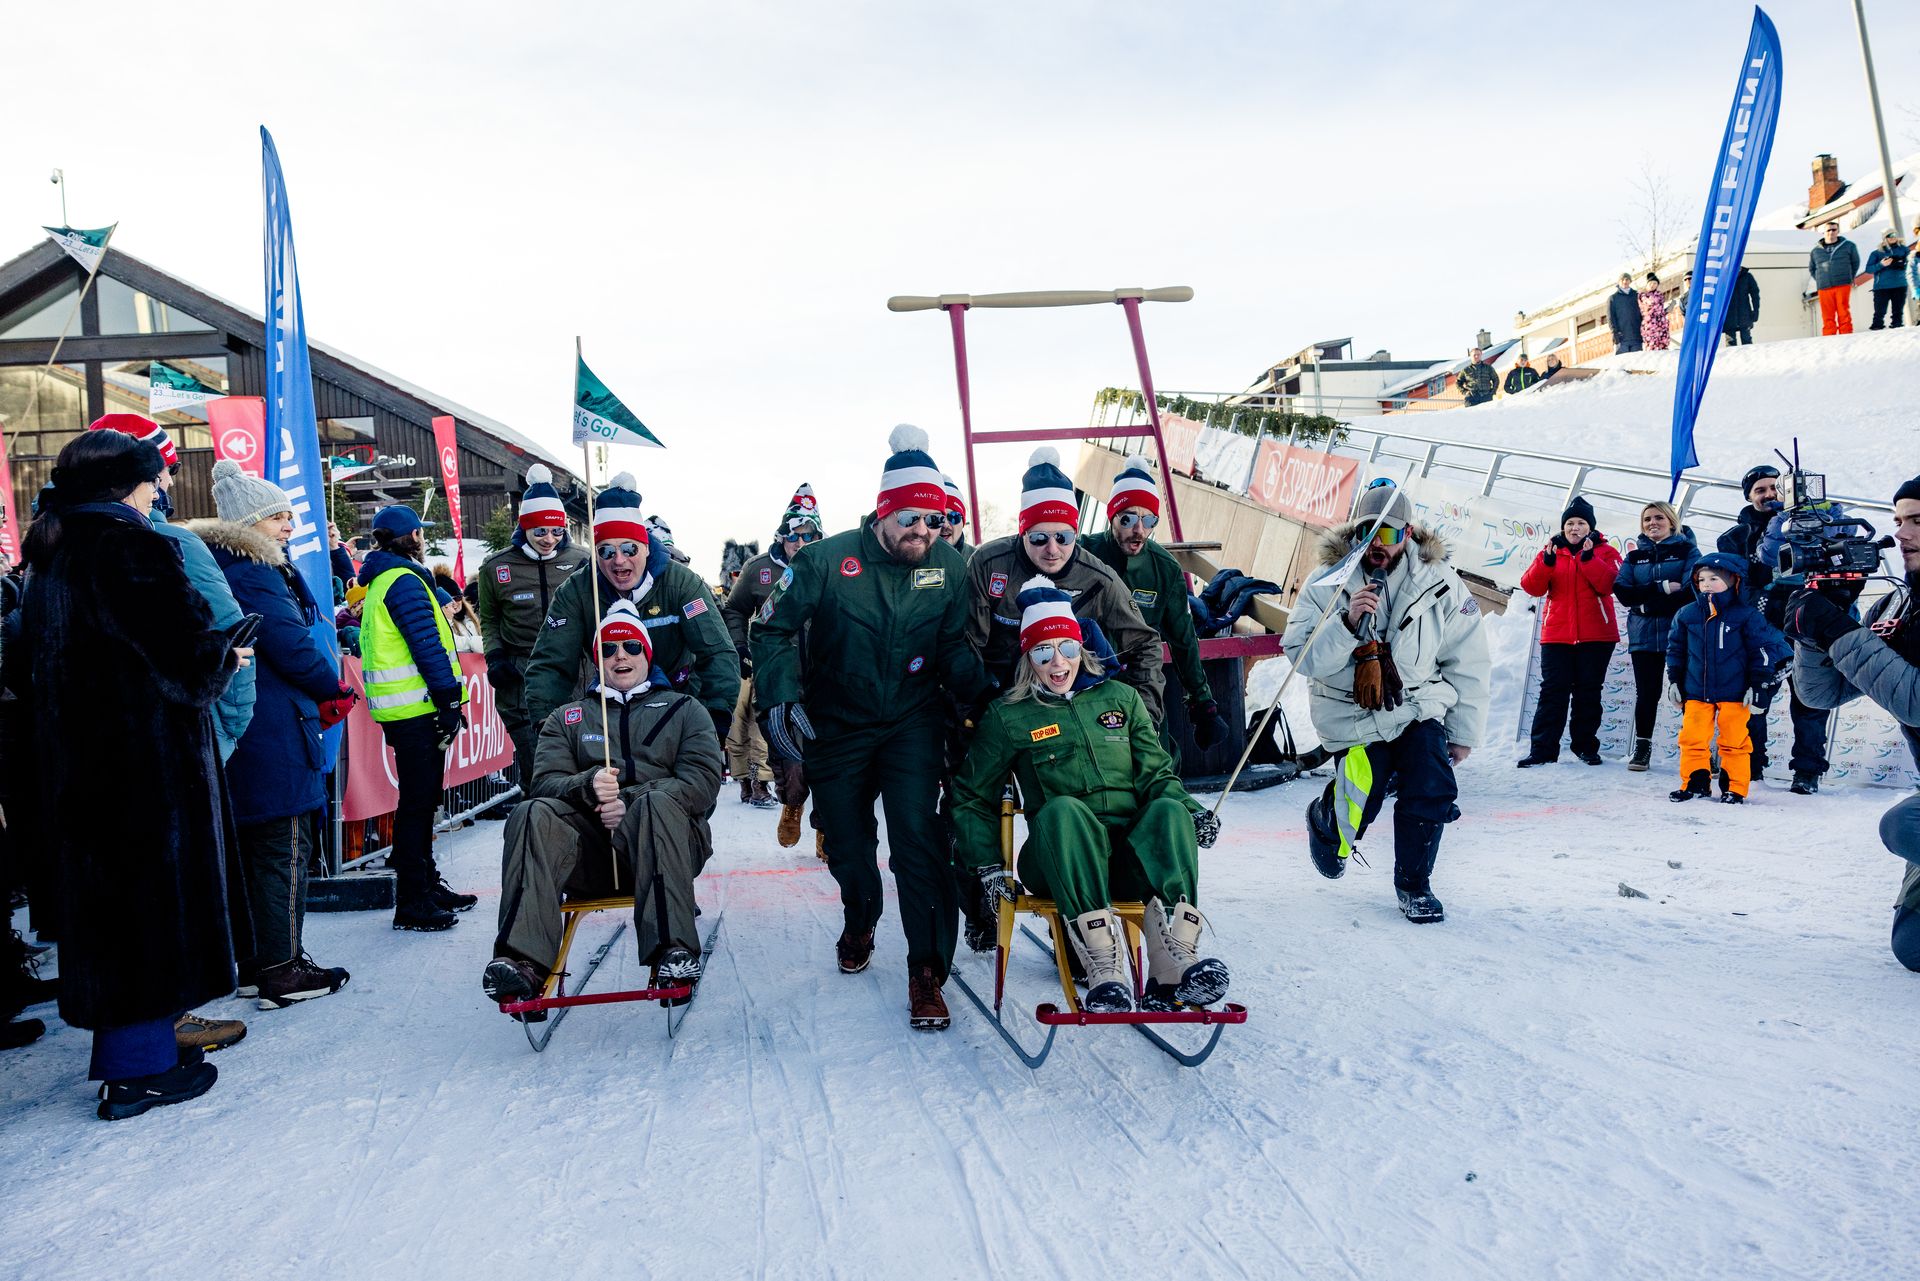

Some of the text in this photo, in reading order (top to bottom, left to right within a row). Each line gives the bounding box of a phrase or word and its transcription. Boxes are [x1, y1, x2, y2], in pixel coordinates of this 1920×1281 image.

[153, 381, 173, 390] ONE
[591, 418, 618, 441] Go!
[1279, 457, 1344, 519] ESPEGARD
[1032, 726, 1057, 740] TOP GUN
